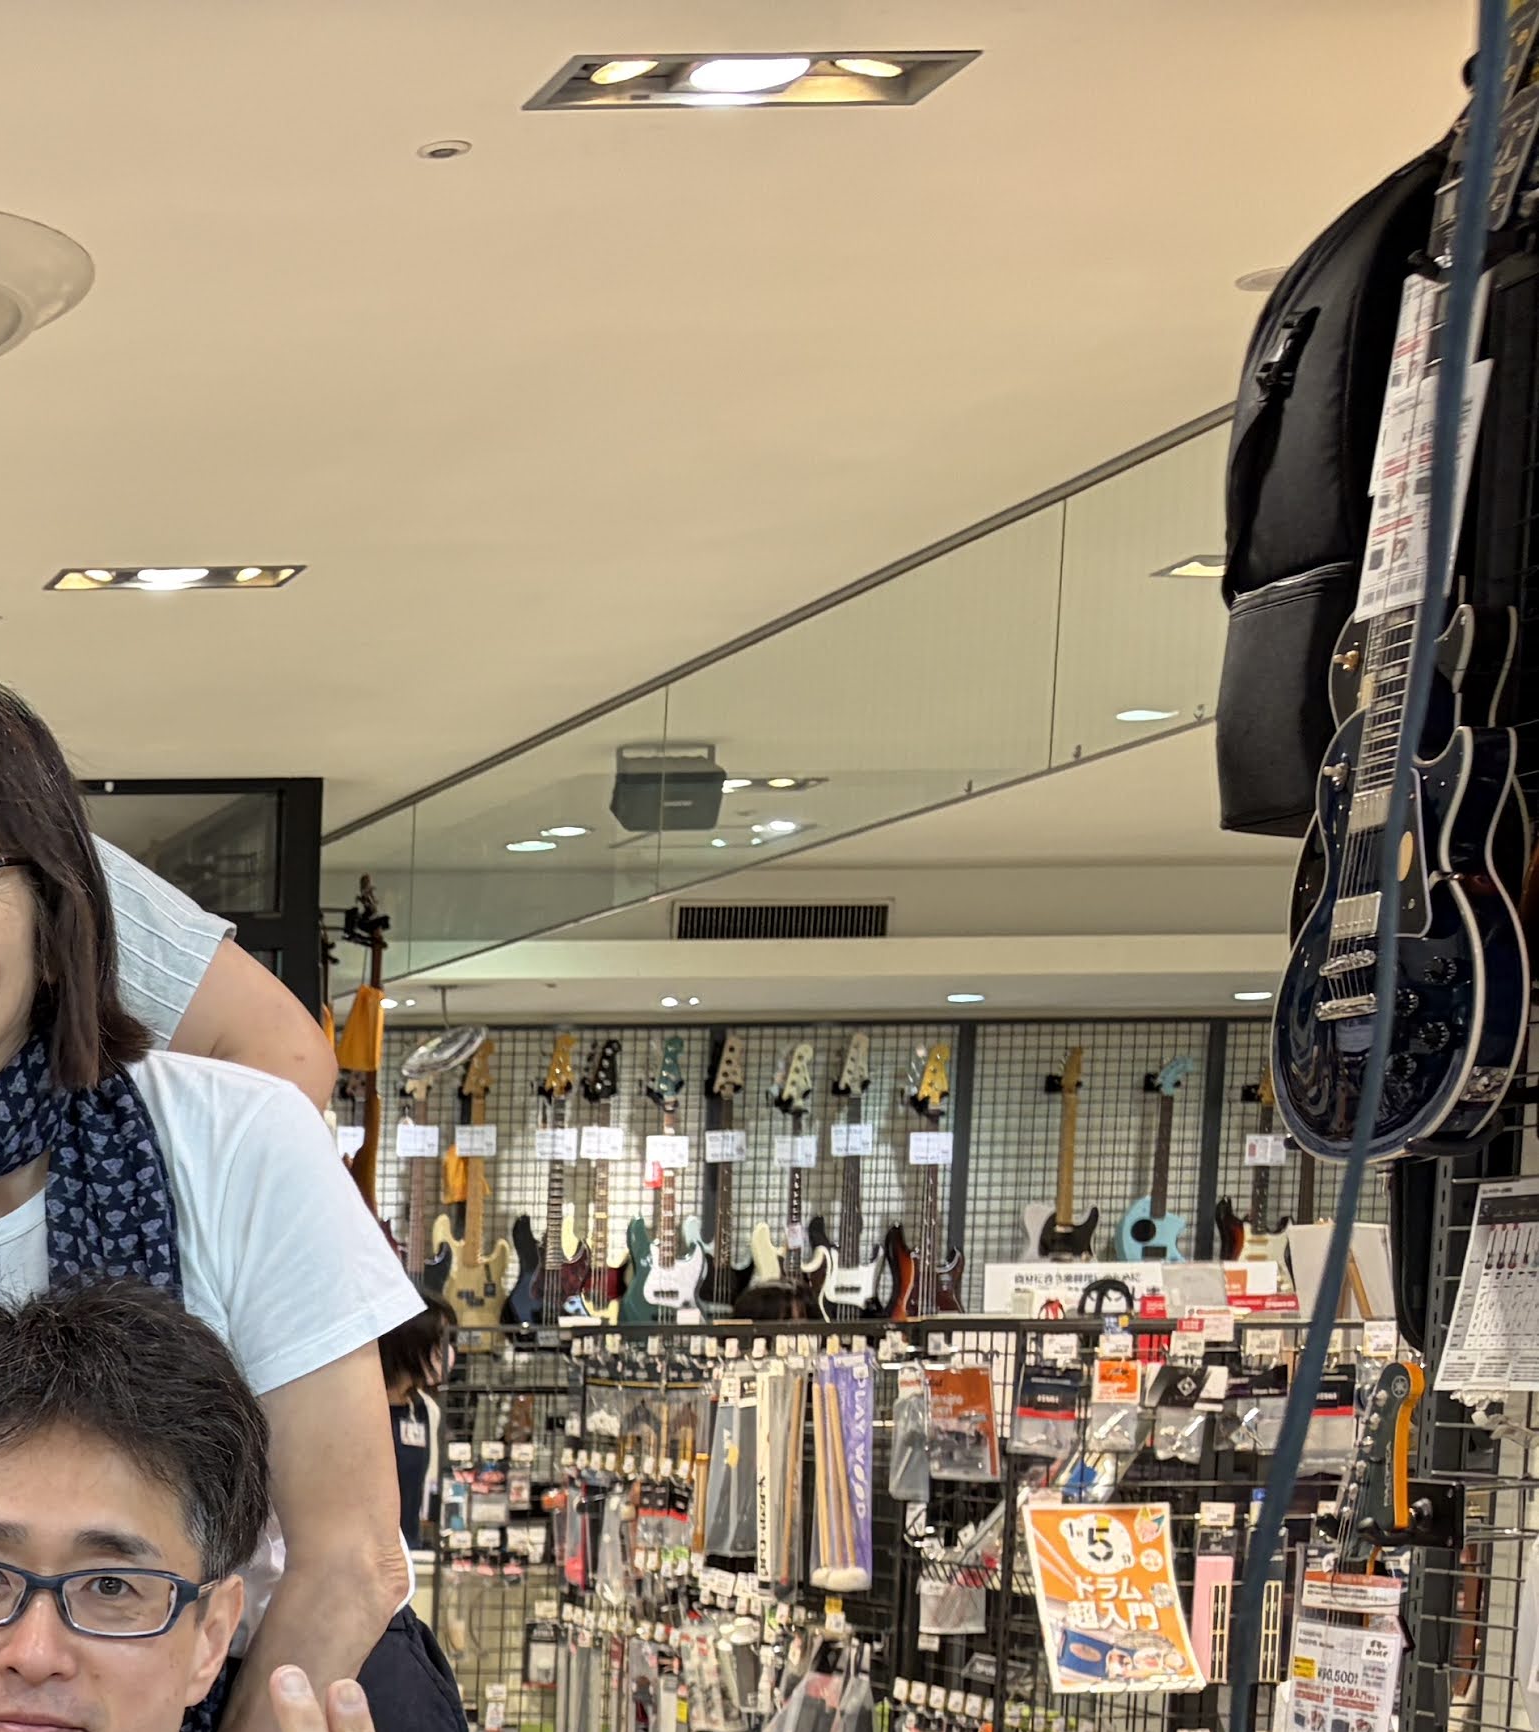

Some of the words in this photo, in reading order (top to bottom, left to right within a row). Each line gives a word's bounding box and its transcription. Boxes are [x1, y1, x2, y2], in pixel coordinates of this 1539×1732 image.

[853, 1443, 866, 1520] WOOD
[1075, 1576, 1143, 1600] ドラム
[1068, 1601, 1160, 1631] 超入門
